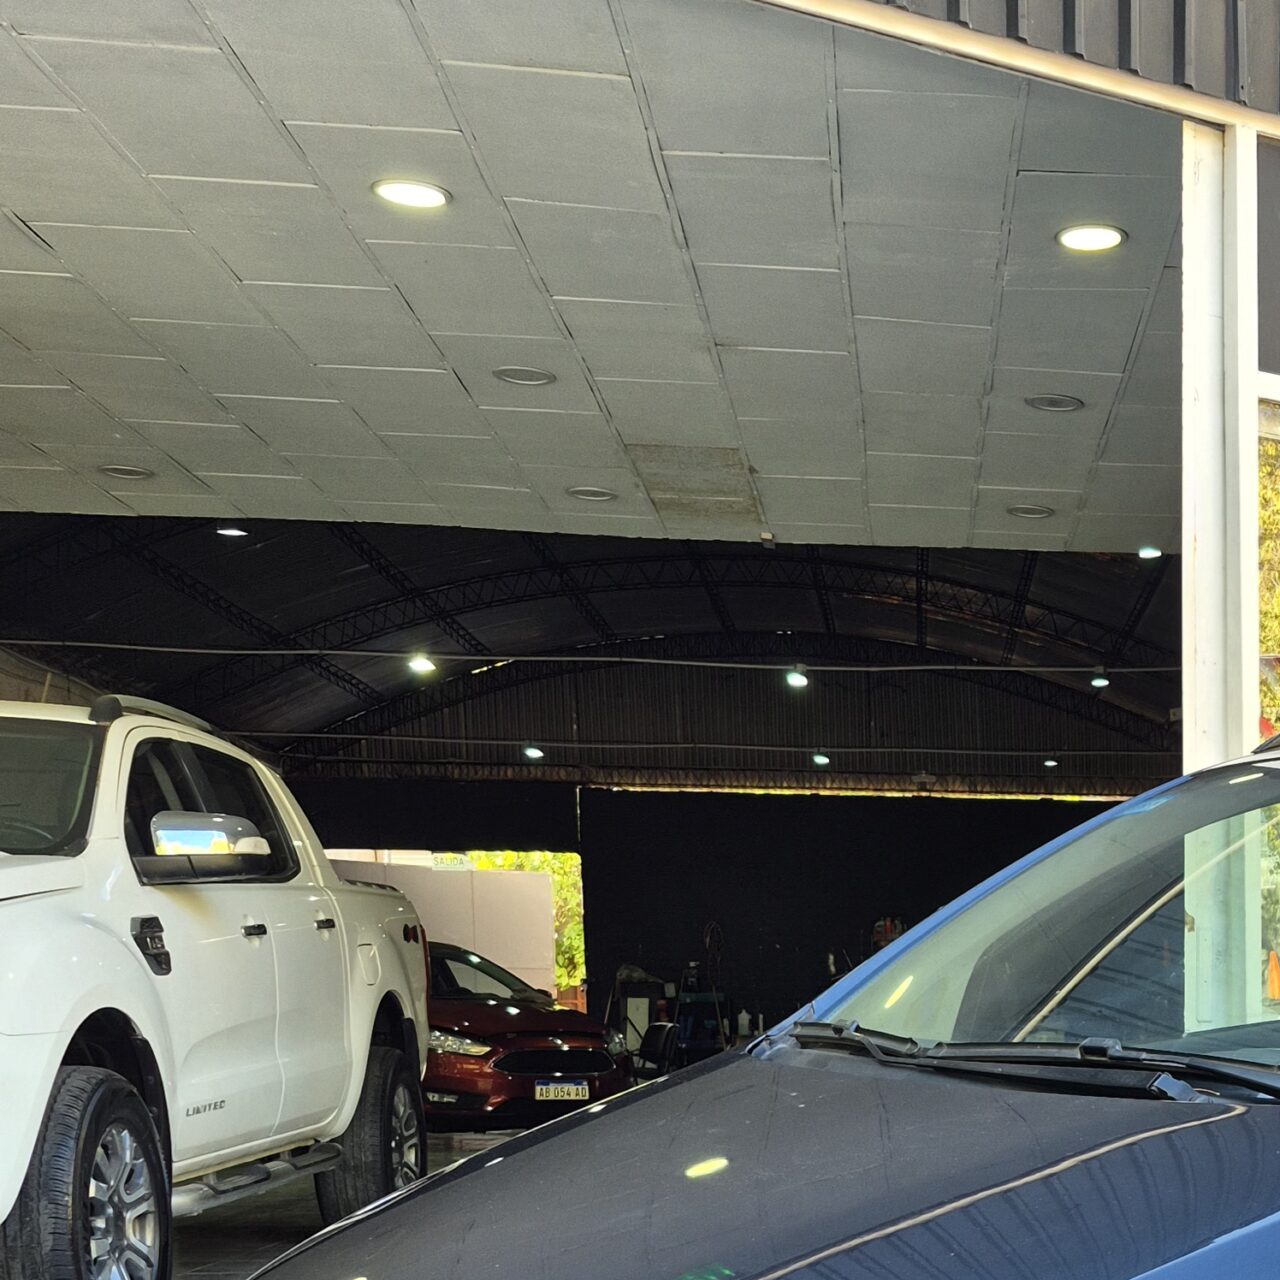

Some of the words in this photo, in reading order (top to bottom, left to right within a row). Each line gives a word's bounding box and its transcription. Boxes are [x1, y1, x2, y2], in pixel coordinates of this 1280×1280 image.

[433, 856, 464, 866] SALIDA
[539, 1087, 551, 1098] AB
[553, 1087, 571, 1098] 054
[575, 1087, 587, 1098] AD
